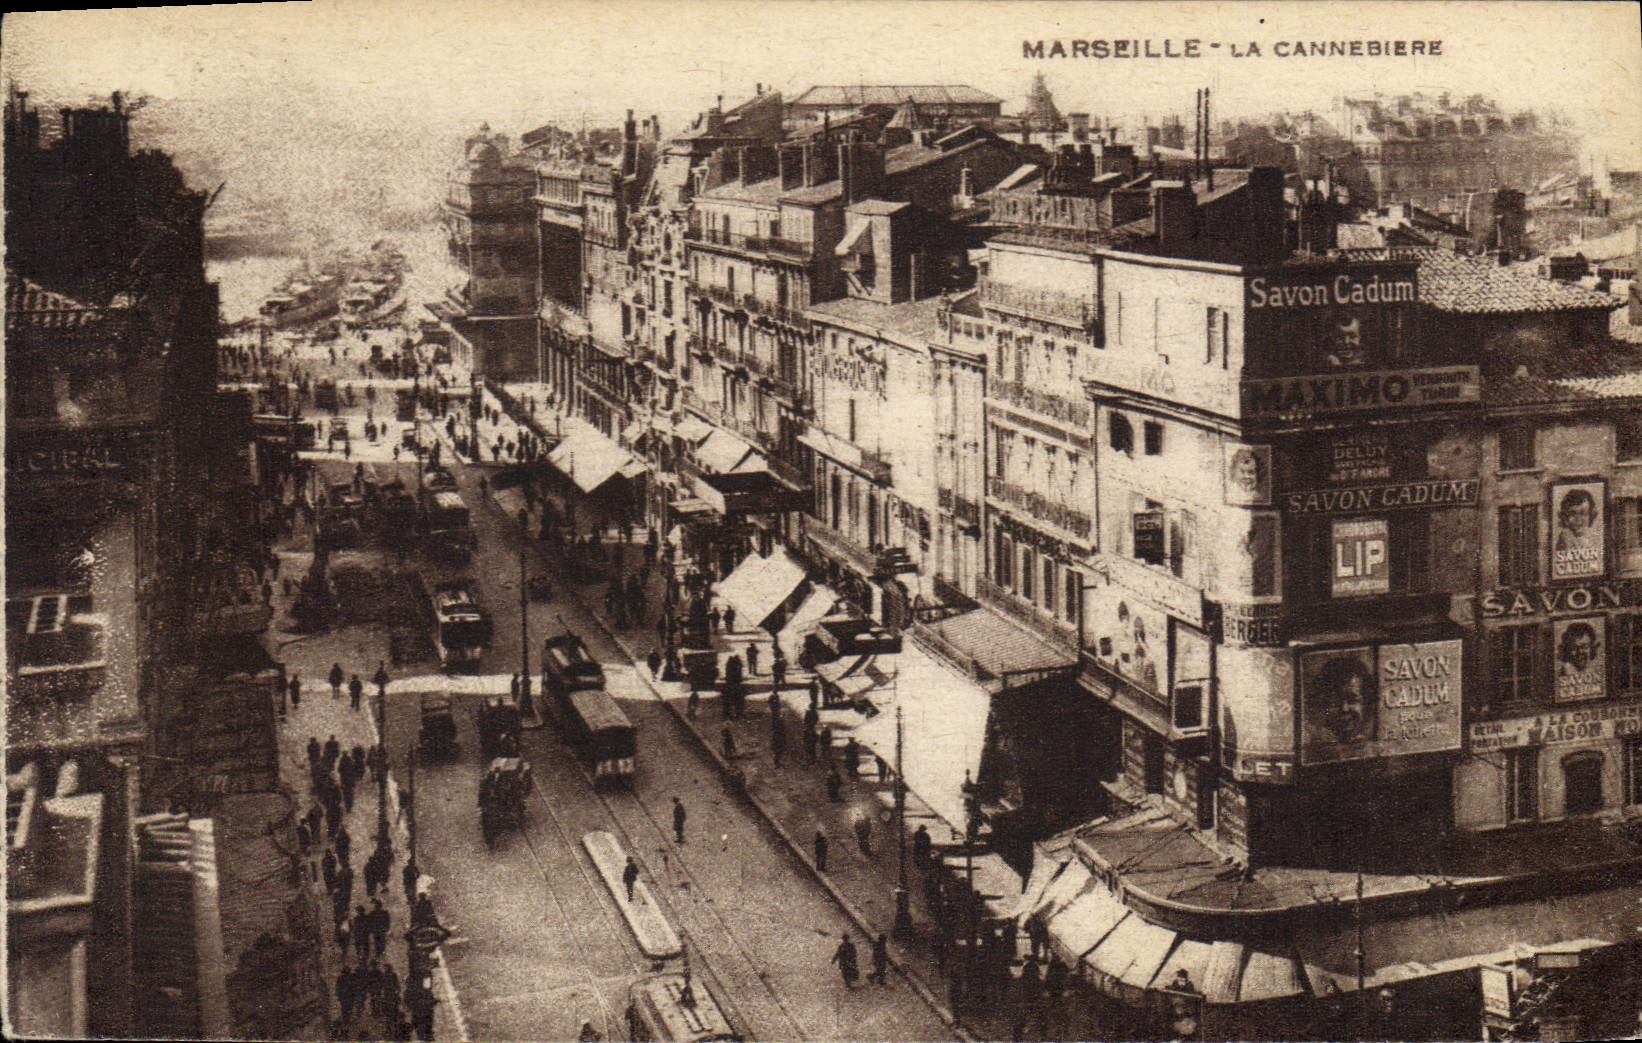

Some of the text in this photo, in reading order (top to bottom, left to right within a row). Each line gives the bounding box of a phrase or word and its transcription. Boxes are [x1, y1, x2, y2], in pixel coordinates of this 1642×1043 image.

[1250, 275, 1415, 308] Savon Cadum
[1250, 374, 1410, 412] MAXIMO
[1287, 482, 1468, 512] SAVON CADUM
[1336, 540, 1385, 577] LIP
[1556, 548, 1598, 562] SAVON
[1556, 562, 1596, 576] CADUM
[1481, 586, 1621, 617] SAVON
[1384, 656, 1450, 681] SAVON
[1559, 672, 1601, 686] SAVON
[1383, 682, 1450, 710] CADUM
[1559, 684, 1602, 698] CADUM
[1527, 721, 1602, 745] MAISON
